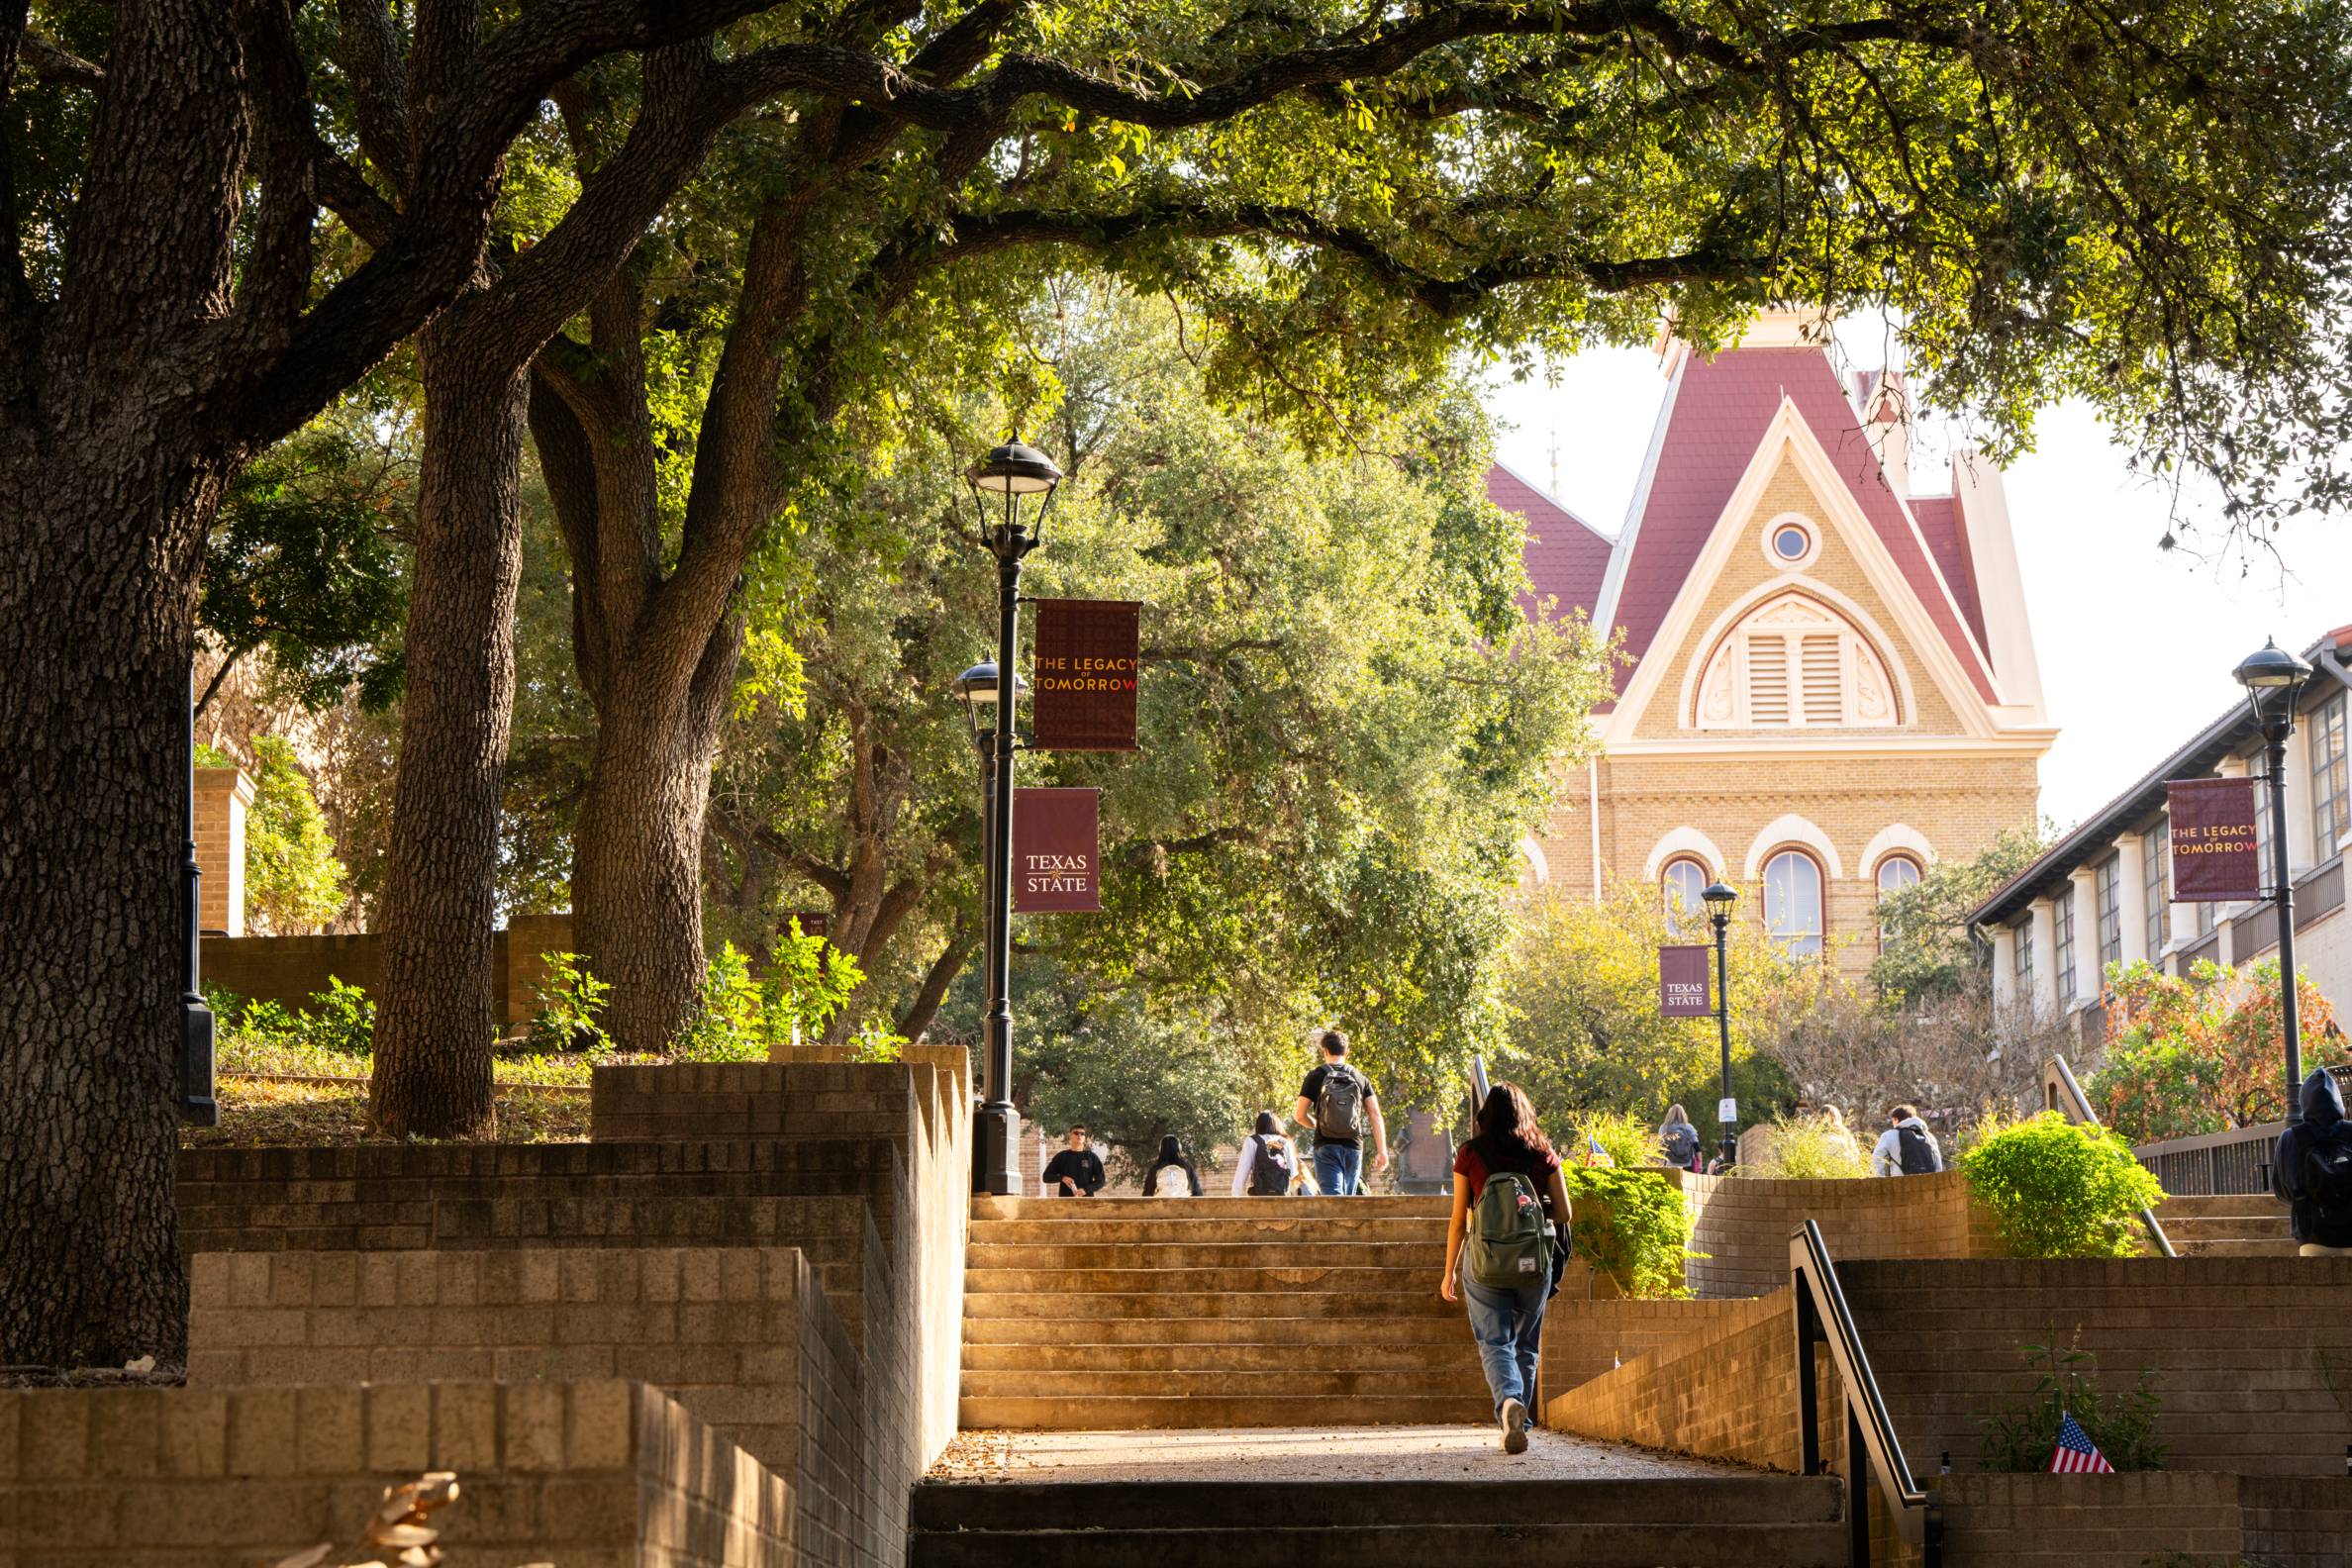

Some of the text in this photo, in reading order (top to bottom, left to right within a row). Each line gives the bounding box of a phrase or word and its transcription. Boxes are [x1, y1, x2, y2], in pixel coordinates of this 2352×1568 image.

[1034, 657, 1137, 671] THE LEGACY
[1033, 677, 1137, 691] TOMORROW
[2171, 825, 2257, 838] THE LEGACY
[2172, 842, 2258, 855] TOMORROW
[1026, 854, 1087, 870] TEXAS
[1028, 877, 1087, 892] STATE
[1667, 983, 1703, 993] TEXAS
[1668, 997, 1703, 1006] STATE
